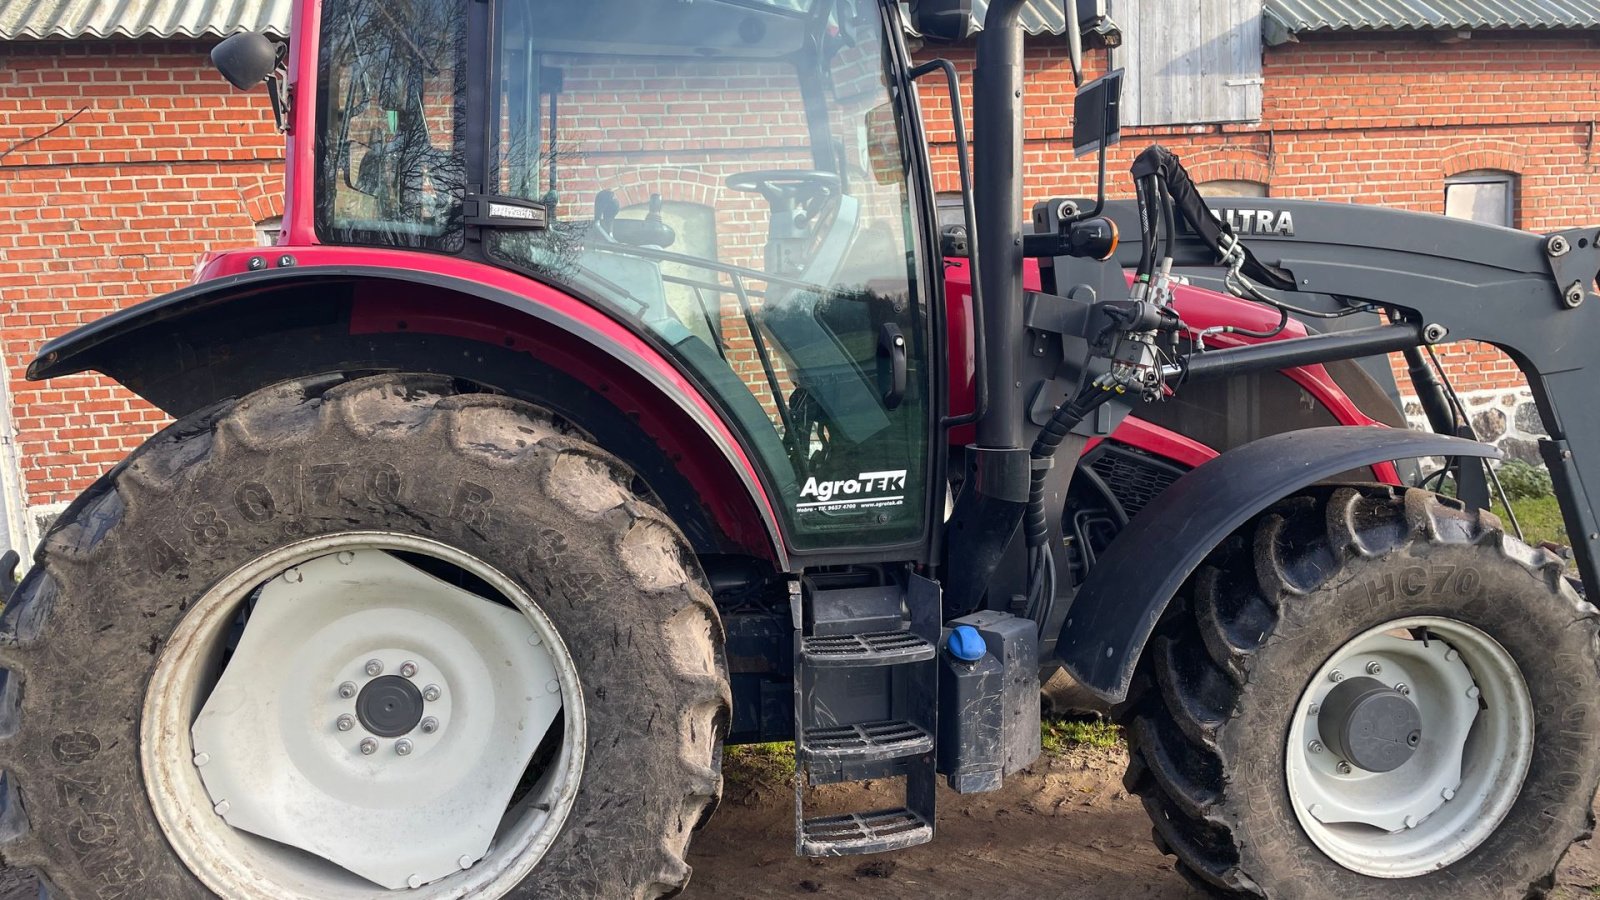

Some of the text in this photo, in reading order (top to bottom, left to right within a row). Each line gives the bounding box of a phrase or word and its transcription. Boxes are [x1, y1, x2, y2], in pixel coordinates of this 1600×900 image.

[447, 477, 496, 531] R
[799, 470, 907, 501] AgroTEK
[860, 500, 904, 509] www.agrotek.dk
[1364, 564, 1480, 608] HC70
